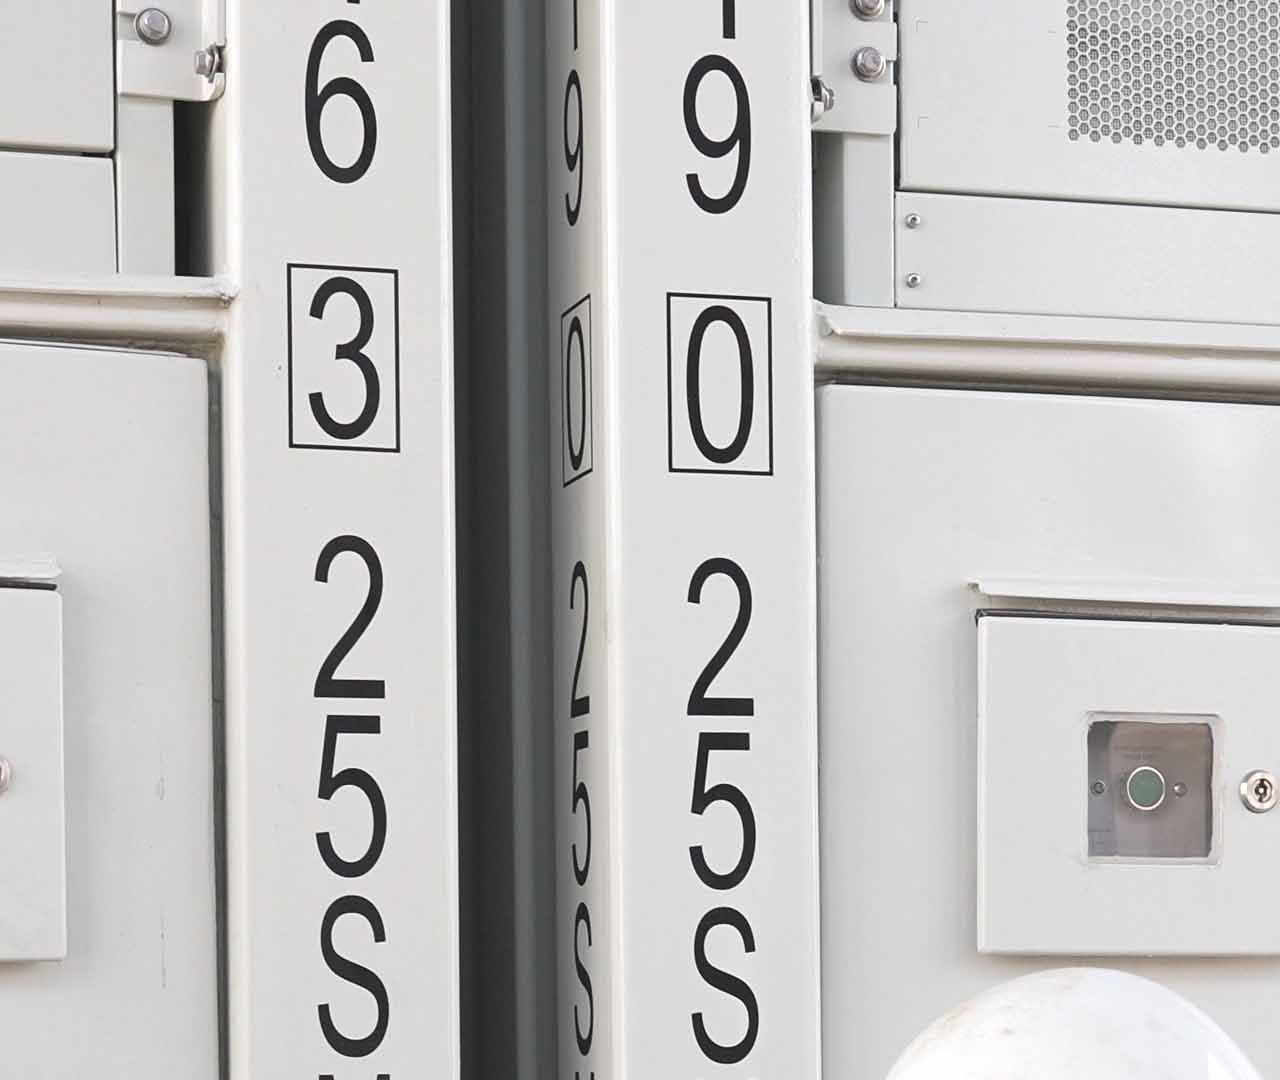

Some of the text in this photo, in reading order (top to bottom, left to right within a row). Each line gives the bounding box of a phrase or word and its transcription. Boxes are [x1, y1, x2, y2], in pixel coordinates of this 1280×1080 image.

[306, 0, 376, 183] 6
[683, 0, 752, 214] 9
[309, 276, 379, 440] 3
[686, 304, 754, 464] 0
